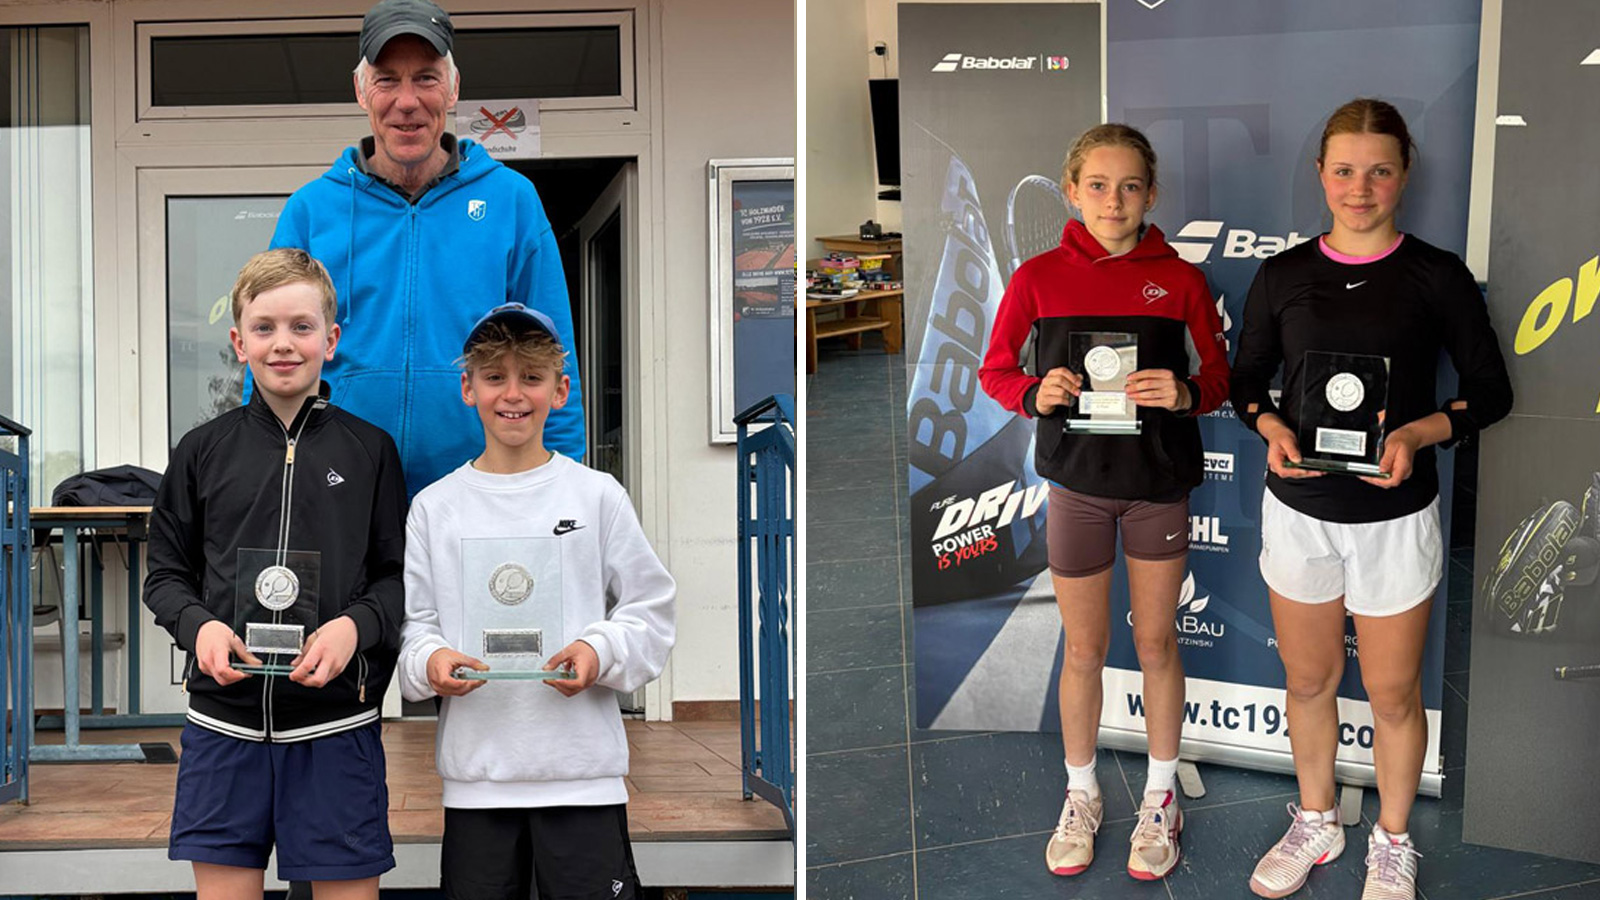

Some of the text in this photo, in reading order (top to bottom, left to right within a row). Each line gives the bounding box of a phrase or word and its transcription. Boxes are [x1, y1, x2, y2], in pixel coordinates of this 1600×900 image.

[931, 480, 1051, 541] DRIV
[932, 524, 996, 557] POWER
[955, 534, 999, 567] YOURS
